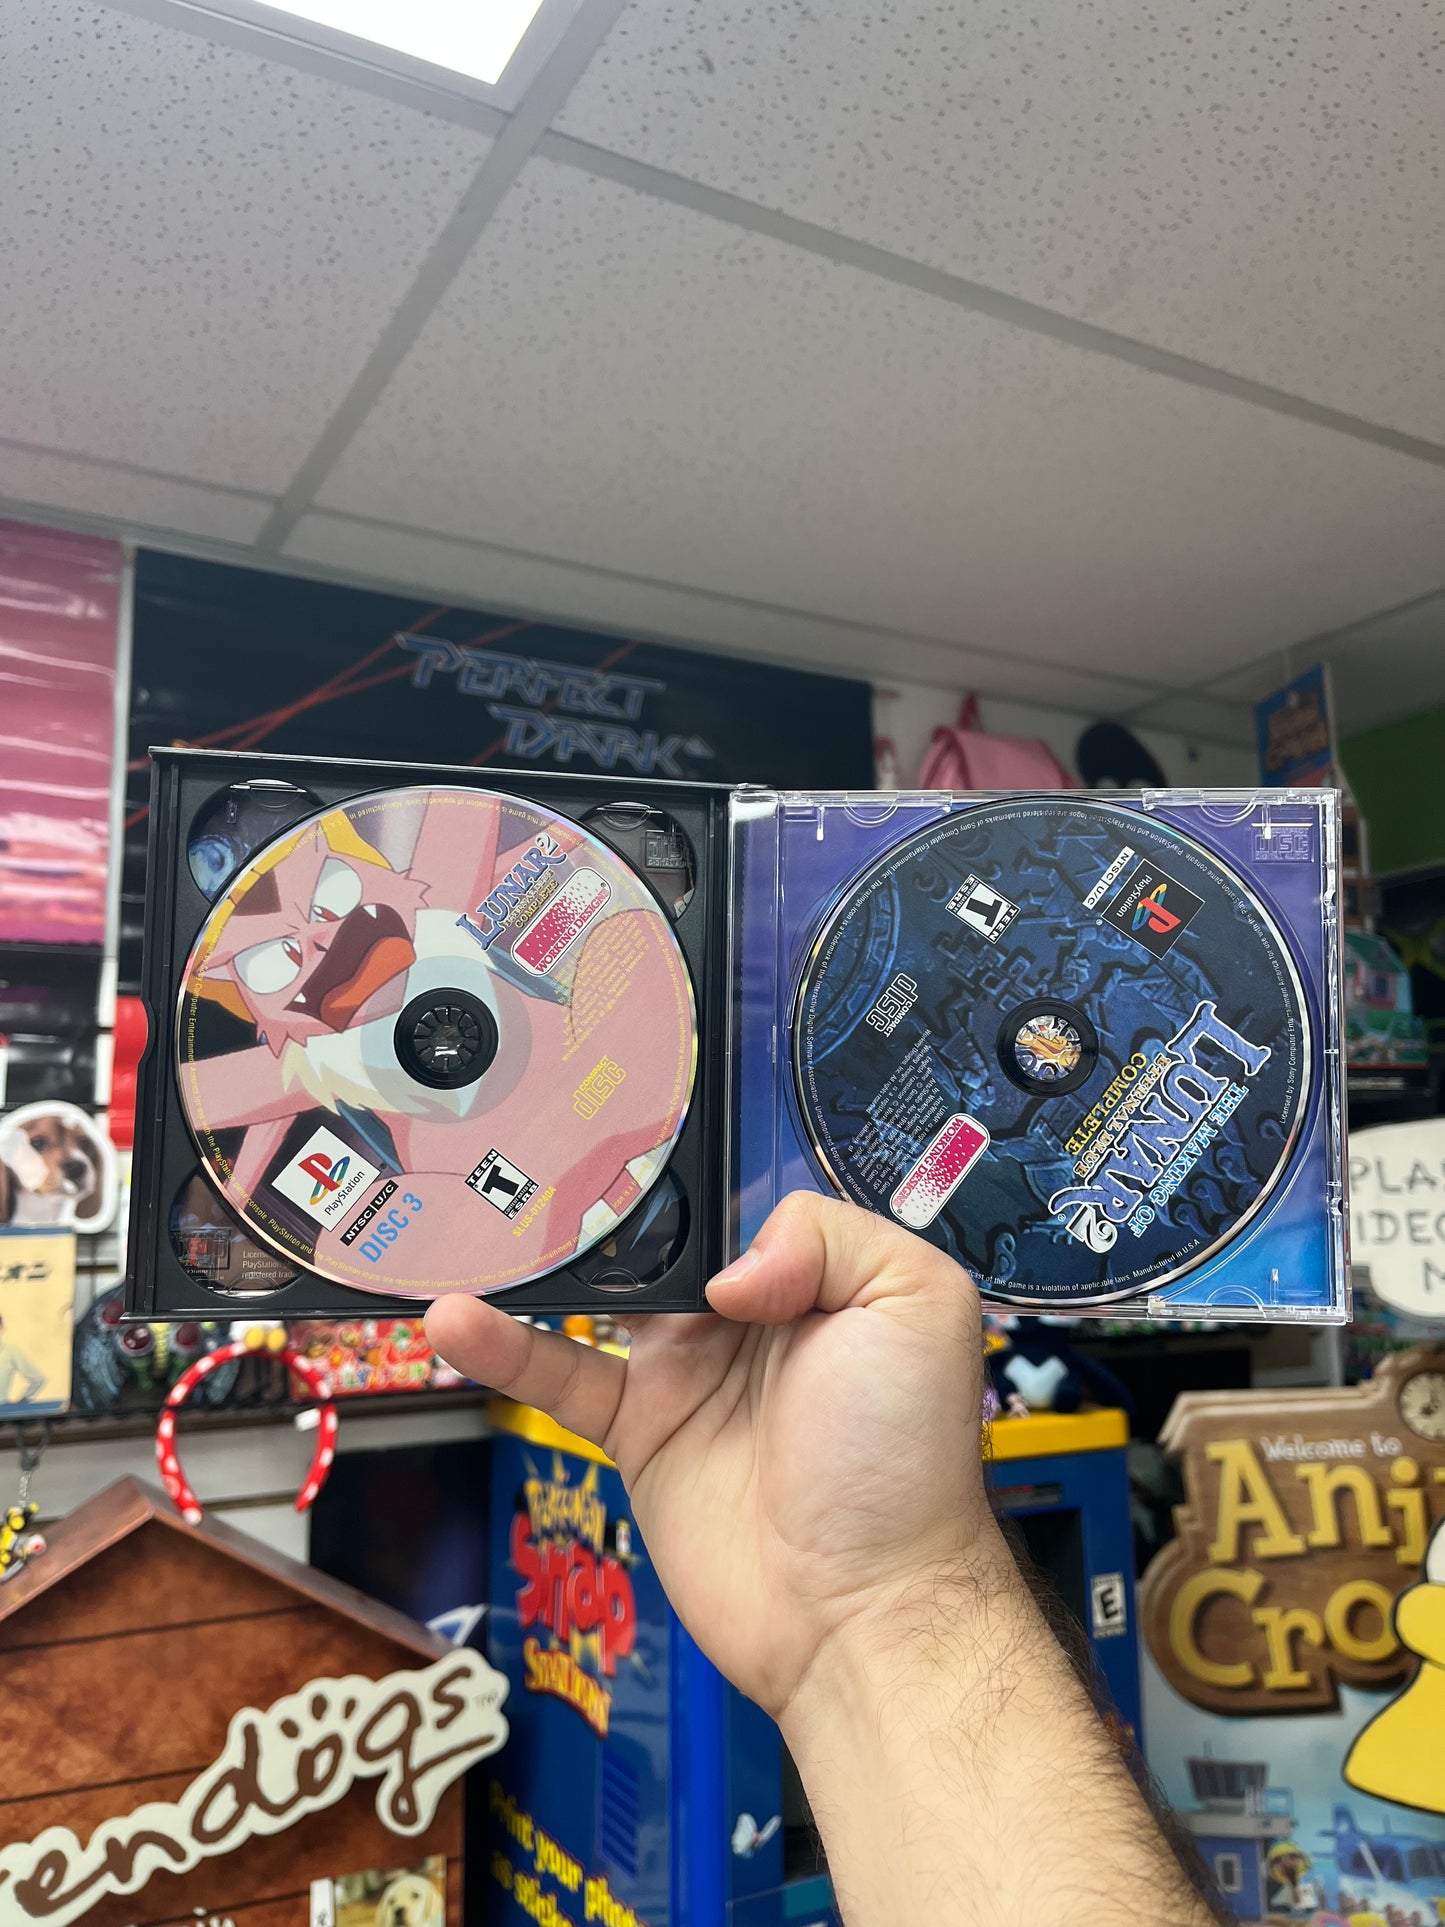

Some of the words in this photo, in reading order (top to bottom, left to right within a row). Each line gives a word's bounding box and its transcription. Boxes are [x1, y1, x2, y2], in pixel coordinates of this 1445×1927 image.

[394, 631, 667, 721] PERFECT
[486, 702, 684, 778] DARK
[348, 812, 357, 820] in
[508, 807, 526, 819] game
[526, 814, 539, 825] this
[959, 820, 976, 833] Sony
[975, 818, 984, 827] of
[984, 811, 1021, 825] trademarks
[1069, 810, 1087, 819] logos
[1126, 823, 1137, 832] the
[928, 825, 959, 846] Computer
[1136, 826, 1150, 838] and
[1148, 831, 1184, 855] PlayStation
[890, 841, 930, 872] Entertainment
[1105, 852, 1131, 882] NTSC
[870, 878, 883, 891] The
[1206, 868, 1224, 884] game
[455, 847, 568, 951] LUNAR
[515, 879, 560, 929] COMPLETE
[853, 886, 874, 908] ratings
[947, 876, 975, 910] ESRB
[1086, 886, 1107, 907] U/C
[1116, 874, 1153, 918] PlayStation
[1219, 881, 1250, 914] PlayStation
[841, 919, 850, 927] is
[845, 906, 859, 921] icon
[966, 897, 1003, 928] T
[989, 908, 1018, 941] TEEN
[823, 930, 843, 961] trademark
[1251, 922, 1264, 938] with
[1261, 936, 1270, 948] use
[534, 927, 577, 973] WORKING
[820, 960, 829, 968] of
[1265, 949, 1275, 959] for
[816, 968, 826, 979] the
[808, 979, 823, 1012] Interactive
[805, 1013, 816, 1034] Digital
[884, 1000, 913, 1038] COMPACT
[188, 1017, 196, 1064] Entertainment
[1288, 1033, 1297, 1065] Computer
[579, 1055, 610, 1091] COMPACT
[1286, 1085, 1294, 1093] by
[1287, 1067, 1296, 1083] Sony
[1064, 1051, 1147, 1156] COMPLETE
[1107, 1052, 1171, 1135] ETERNAL
[1208, 1081, 1250, 1127] THE
[1278, 1094, 1292, 1124] Licensed
[814, 1105, 834, 1147] Unauthorized
[1049, 1000, 1272, 1223] LUNAR
[207, 1135, 216, 1146] the
[926, 1118, 964, 1168] WORKING
[1073, 1132, 1114, 1178] BLUE
[211, 1146, 236, 1181] PlayStation
[466, 1150, 499, 1184] TEEN
[1150, 1120, 1220, 1207] MAKING
[1351, 1157, 1445, 1194] PLA
[324, 1170, 365, 1216] PlayStation
[481, 1164, 519, 1197] T
[345, 1210, 373, 1241] NTSC
[374, 1184, 395, 1205] U/C
[507, 1184, 538, 1219] ESRB
[266, 1218, 301, 1247] PlayStation
[358, 1209, 409, 1263] DISC
[402, 1192, 424, 1212] 3
[1064, 1205, 1118, 1253] 2
[1126, 1203, 1156, 1239] OF
[299, 1242, 313, 1254] and
[984, 1274, 992, 1282] of
[992, 1277, 1006, 1286] this
[1007, 1281, 1025, 1290] game
[1080, 1277, 1114, 1291] applicable
[1131, 1253, 1176, 1278] Manufactured
[1174, 1249, 1183, 1258] in
[1261, 1437, 1365, 1463] Welcome
[1371, 1433, 1402, 1456] to
[1205, 1440, 1445, 1564] Ani
[510, 1512, 637, 1677] Snap
[1100, 1587, 1119, 1620] E
[534, 1829, 584, 1893] your
